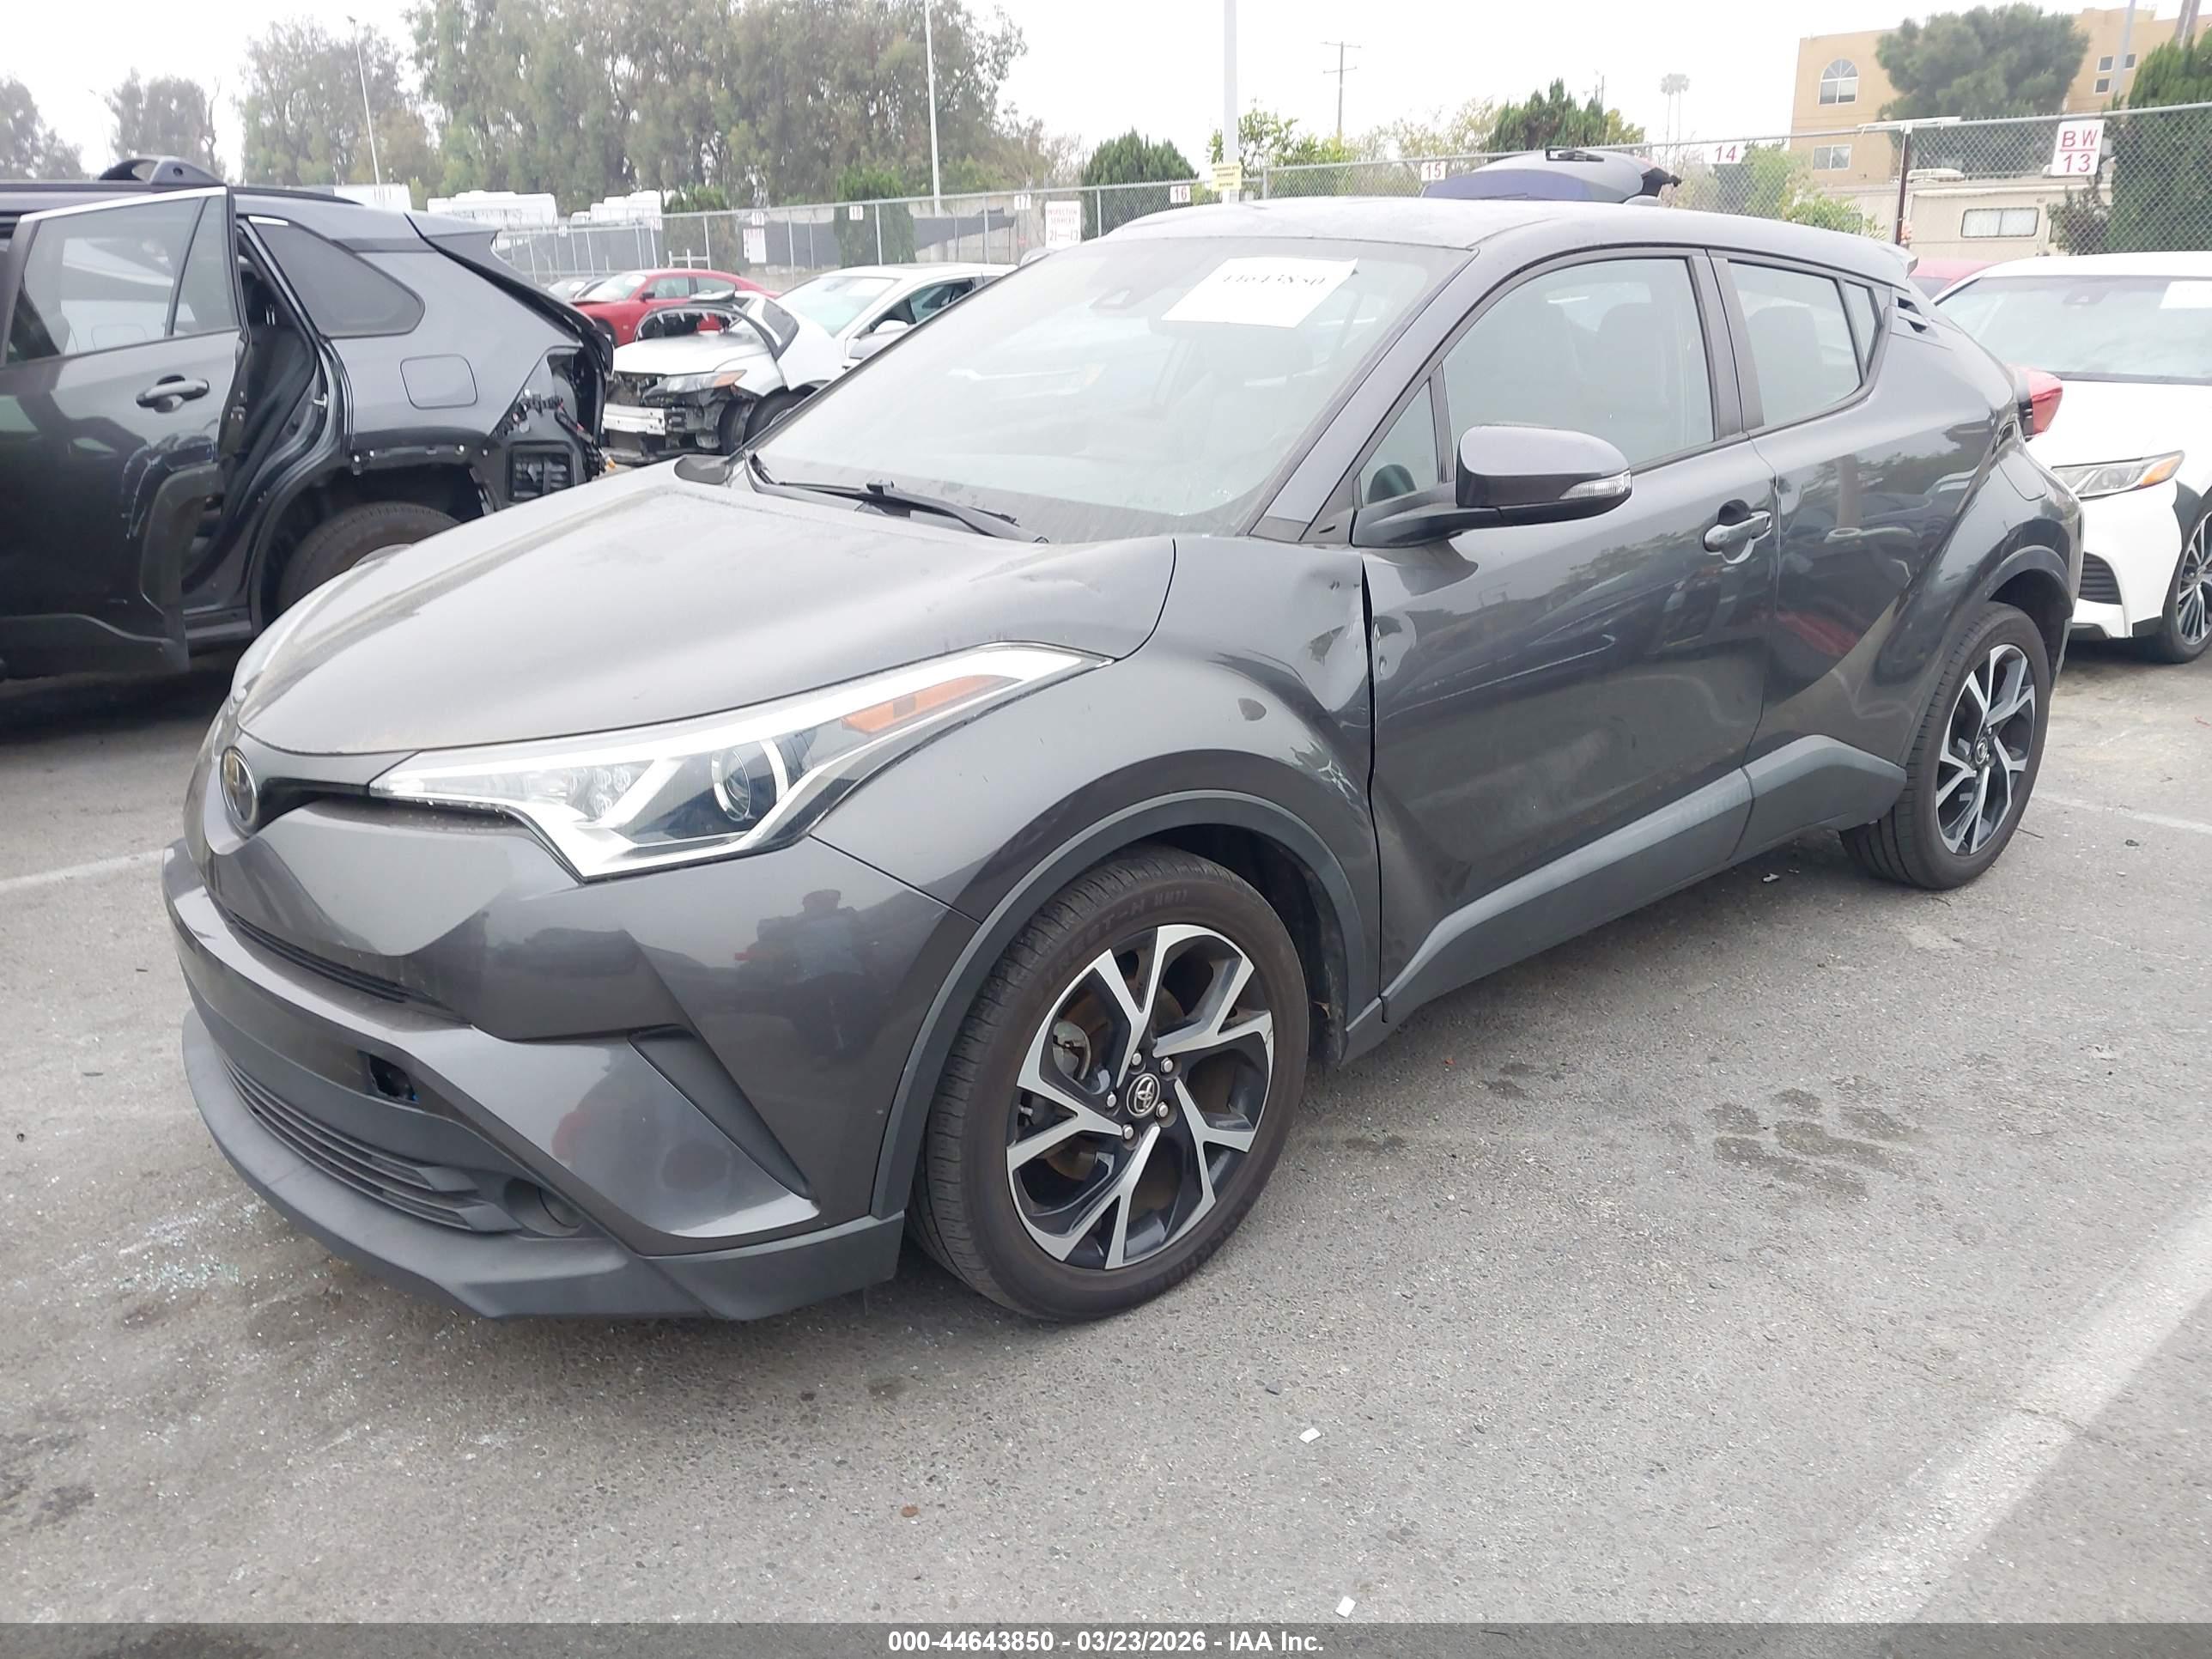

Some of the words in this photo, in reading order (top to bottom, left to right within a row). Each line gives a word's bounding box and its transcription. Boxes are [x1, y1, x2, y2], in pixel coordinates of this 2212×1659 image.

[2062, 129, 2098, 147] BW
[1716, 145, 1737, 162] 14
[1426, 162, 1442, 179] 15
[2063, 153, 2090, 173] 13
[1175, 185, 1188, 201] 16
